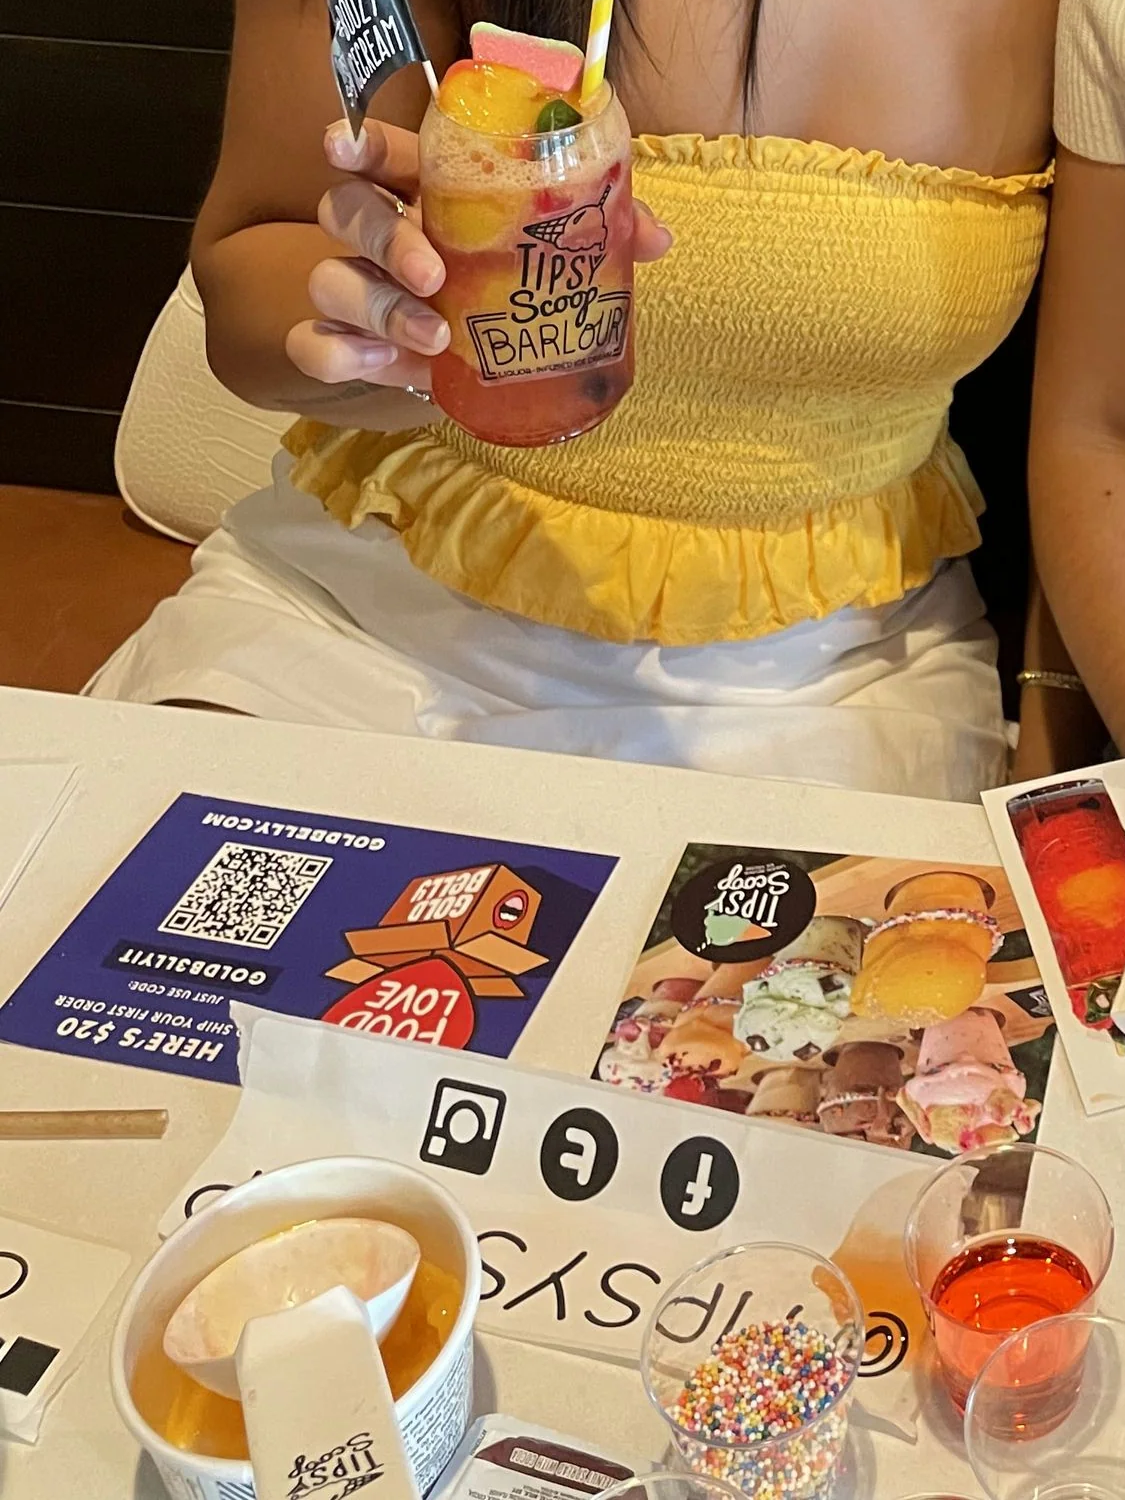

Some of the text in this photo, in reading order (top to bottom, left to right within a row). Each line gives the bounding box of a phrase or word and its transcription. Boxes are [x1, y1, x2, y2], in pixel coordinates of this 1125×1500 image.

[517, 243, 607, 294] TIPSY
[509, 287, 598, 328] Scoop
[482, 306, 623, 366] BARLOUR
[200, 811, 386, 851] GOLDBELLY.COM
[717, 863, 790, 896] Scoop
[406, 893, 475, 921] GOLD
[704, 889, 778, 927] TIPSY
[117, 948, 268, 986] GOLDB3LLYIT
[54, 993, 105, 1013] ORDER
[127, 980, 224, 1006] JUST USE CODE:
[364, 979, 461, 1016] LOVE
[106, 1005, 149, 1021] FIRST
[150, 1011, 193, 1029] YOUR
[195, 1019, 234, 1036] SHIP
[56, 1015, 224, 1062] HERE'S $20
[284, 1449, 385, 1499] TIPSY
